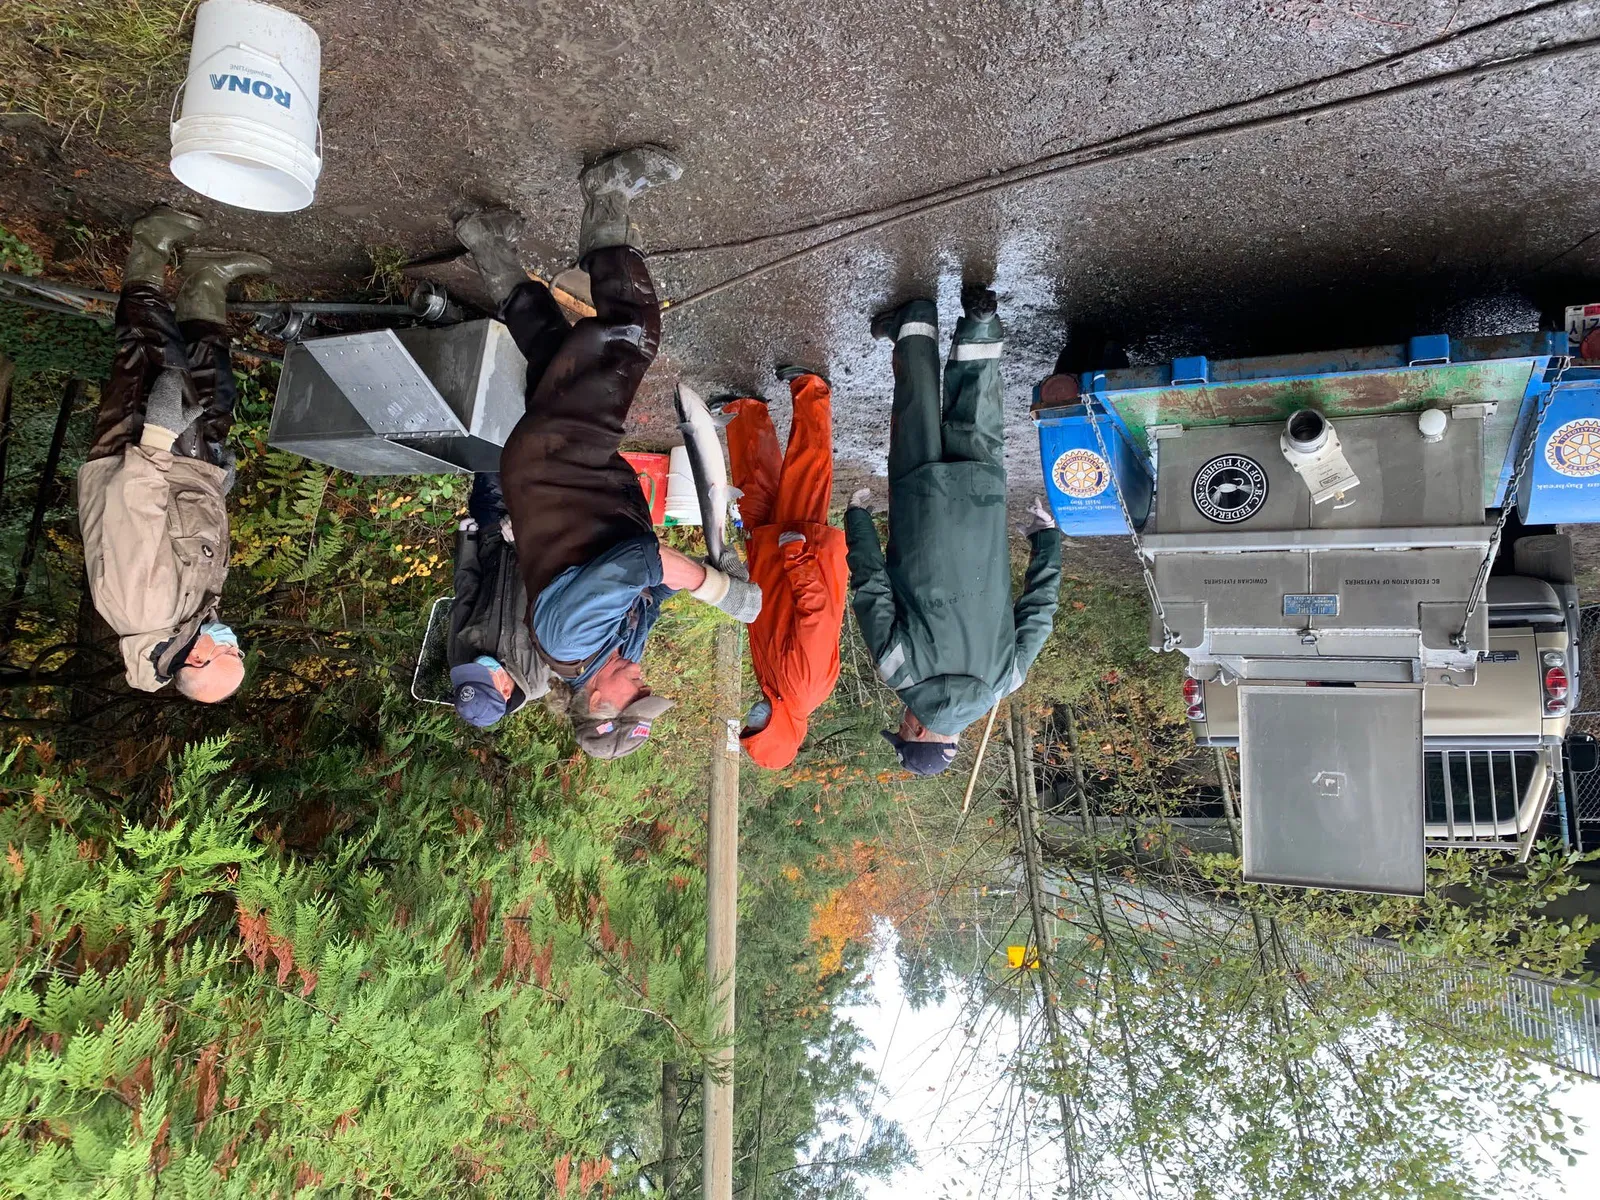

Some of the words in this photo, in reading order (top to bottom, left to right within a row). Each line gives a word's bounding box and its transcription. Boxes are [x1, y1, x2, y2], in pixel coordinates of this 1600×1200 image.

[209, 73, 291, 110] RONA
[1559, 427, 1600, 443] RNATIONAL
[1198, 459, 1232, 486] FISHERS
[1234, 459, 1252, 471] FLY
[1249, 469, 1262, 482] OF
[1536, 482, 1583, 491] Daybreak
[1249, 489, 1263, 505] B.C.
[1197, 491, 1252, 520] FEDERATION
